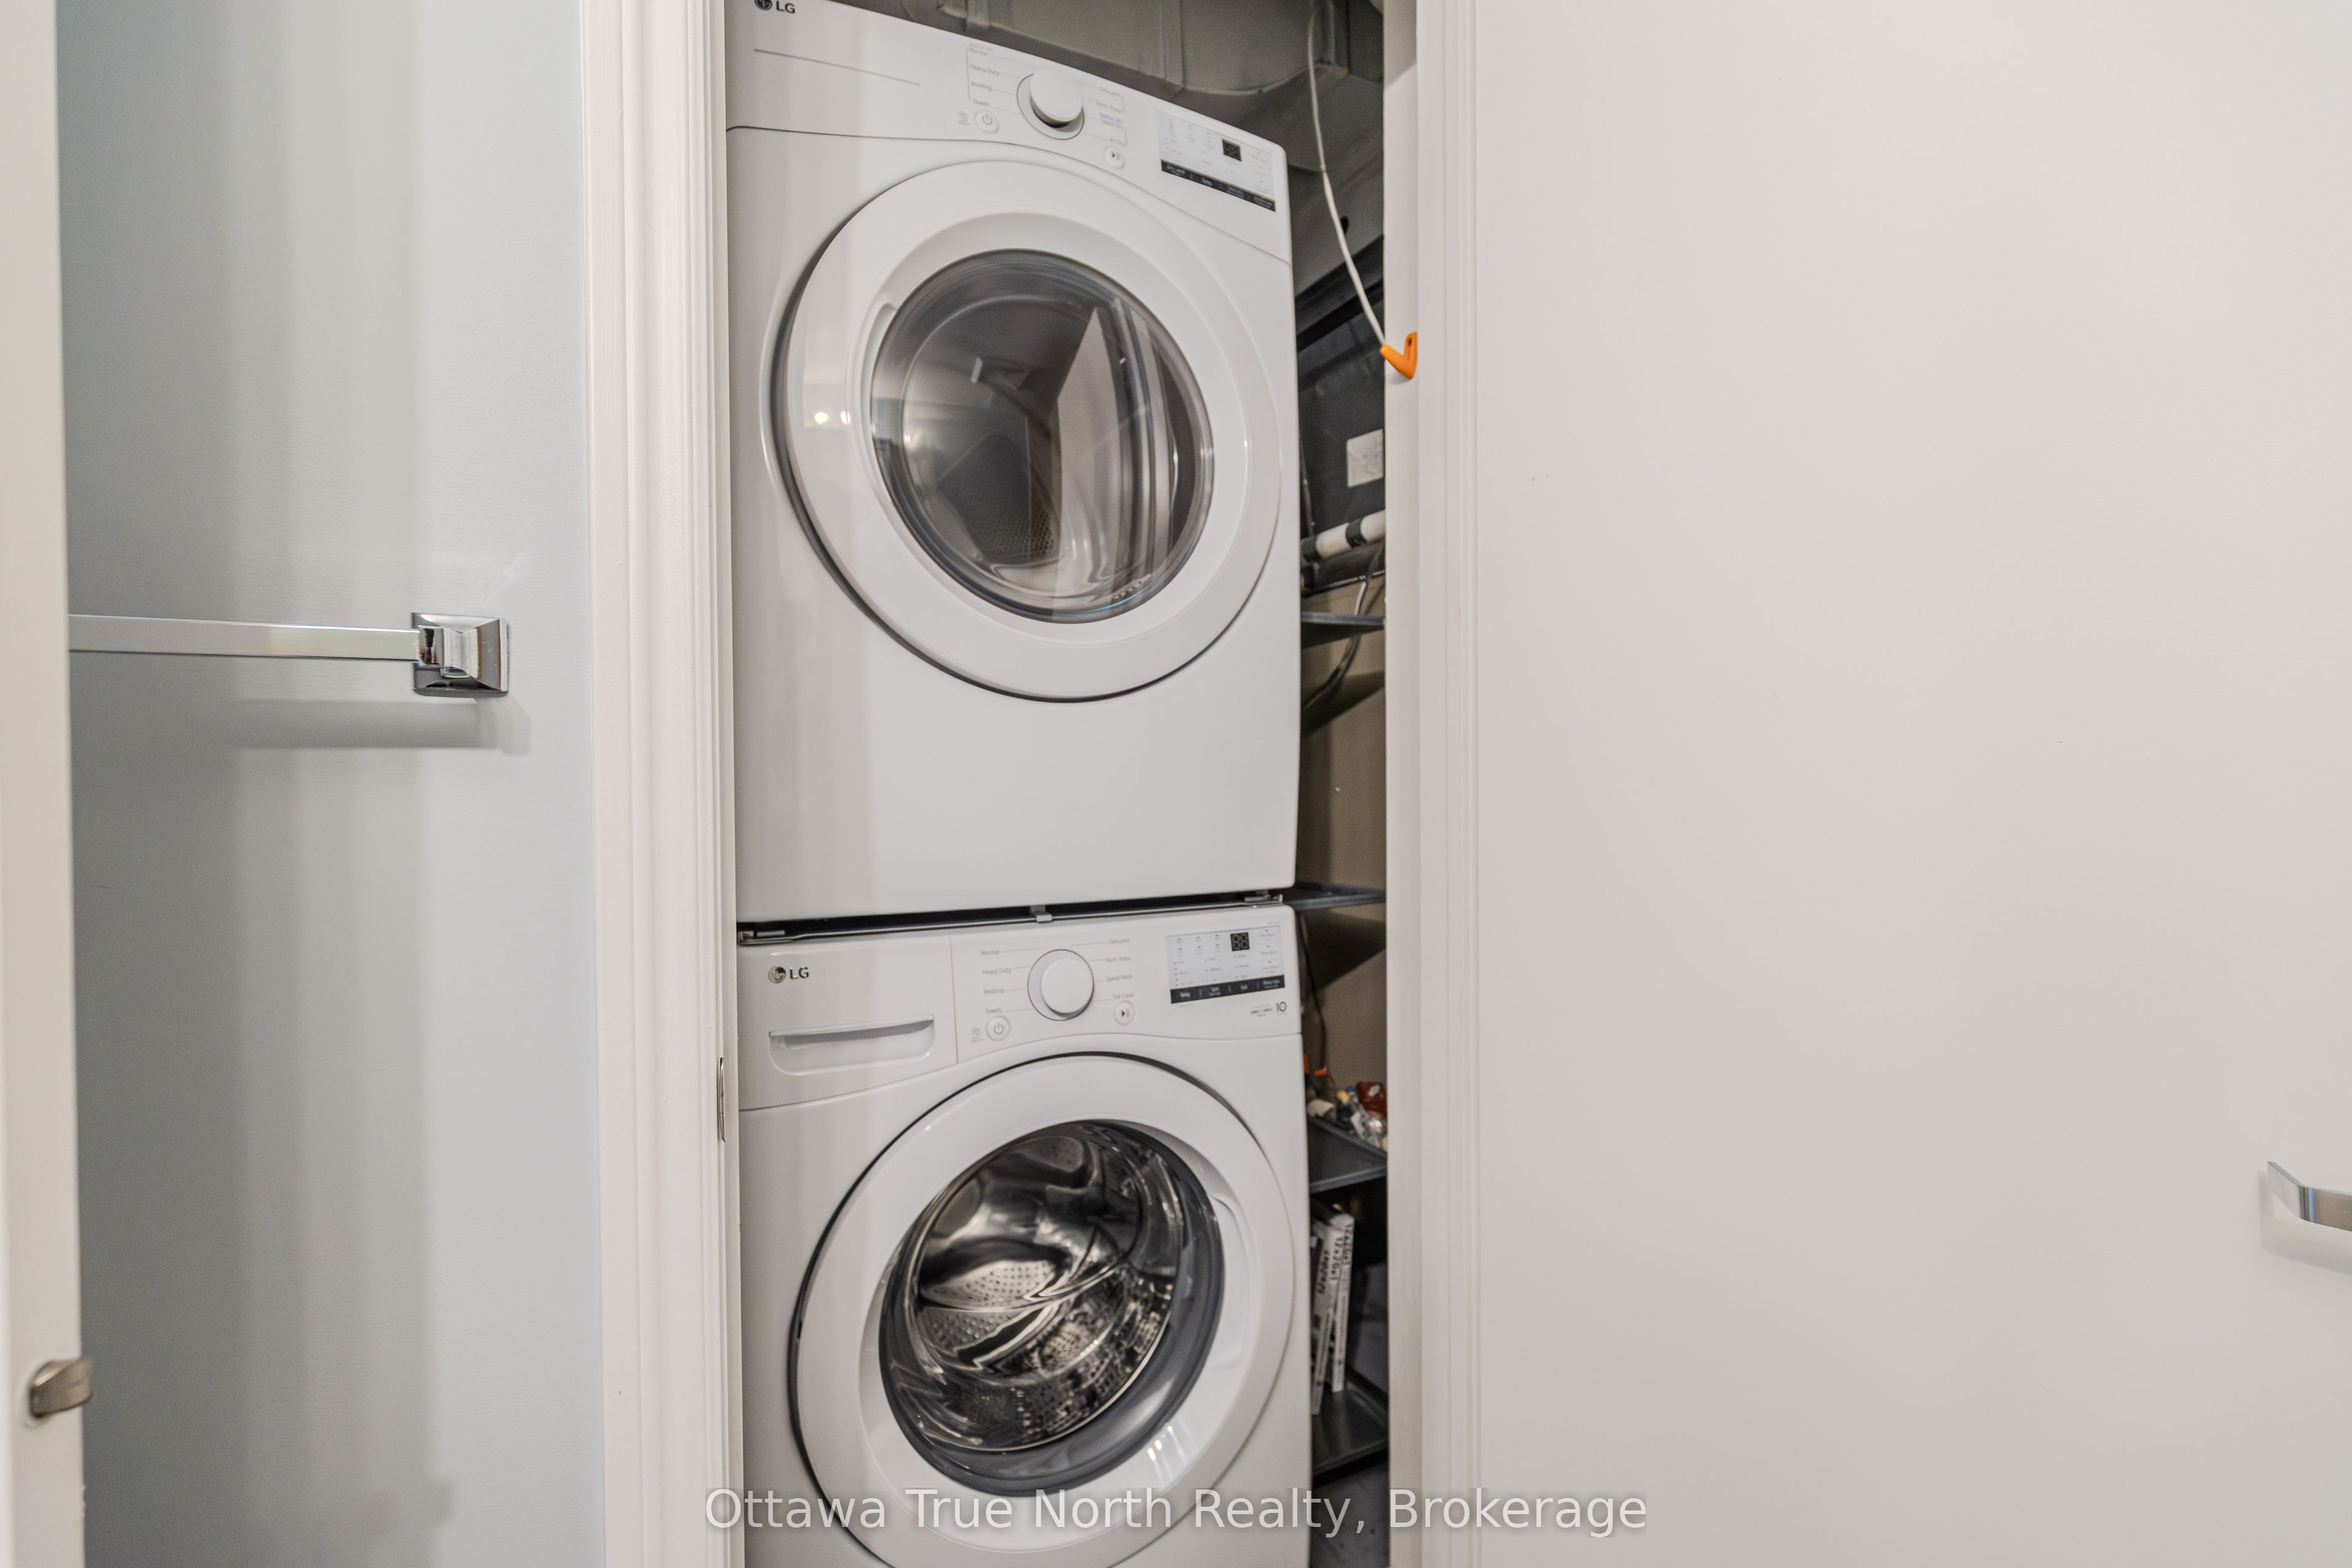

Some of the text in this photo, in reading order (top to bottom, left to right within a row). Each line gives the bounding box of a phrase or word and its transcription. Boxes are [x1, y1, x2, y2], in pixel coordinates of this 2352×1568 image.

[776, 1, 796, 13] LG
[790, 967, 809, 979] LG
[1276, 1001, 1287, 1012] 10
